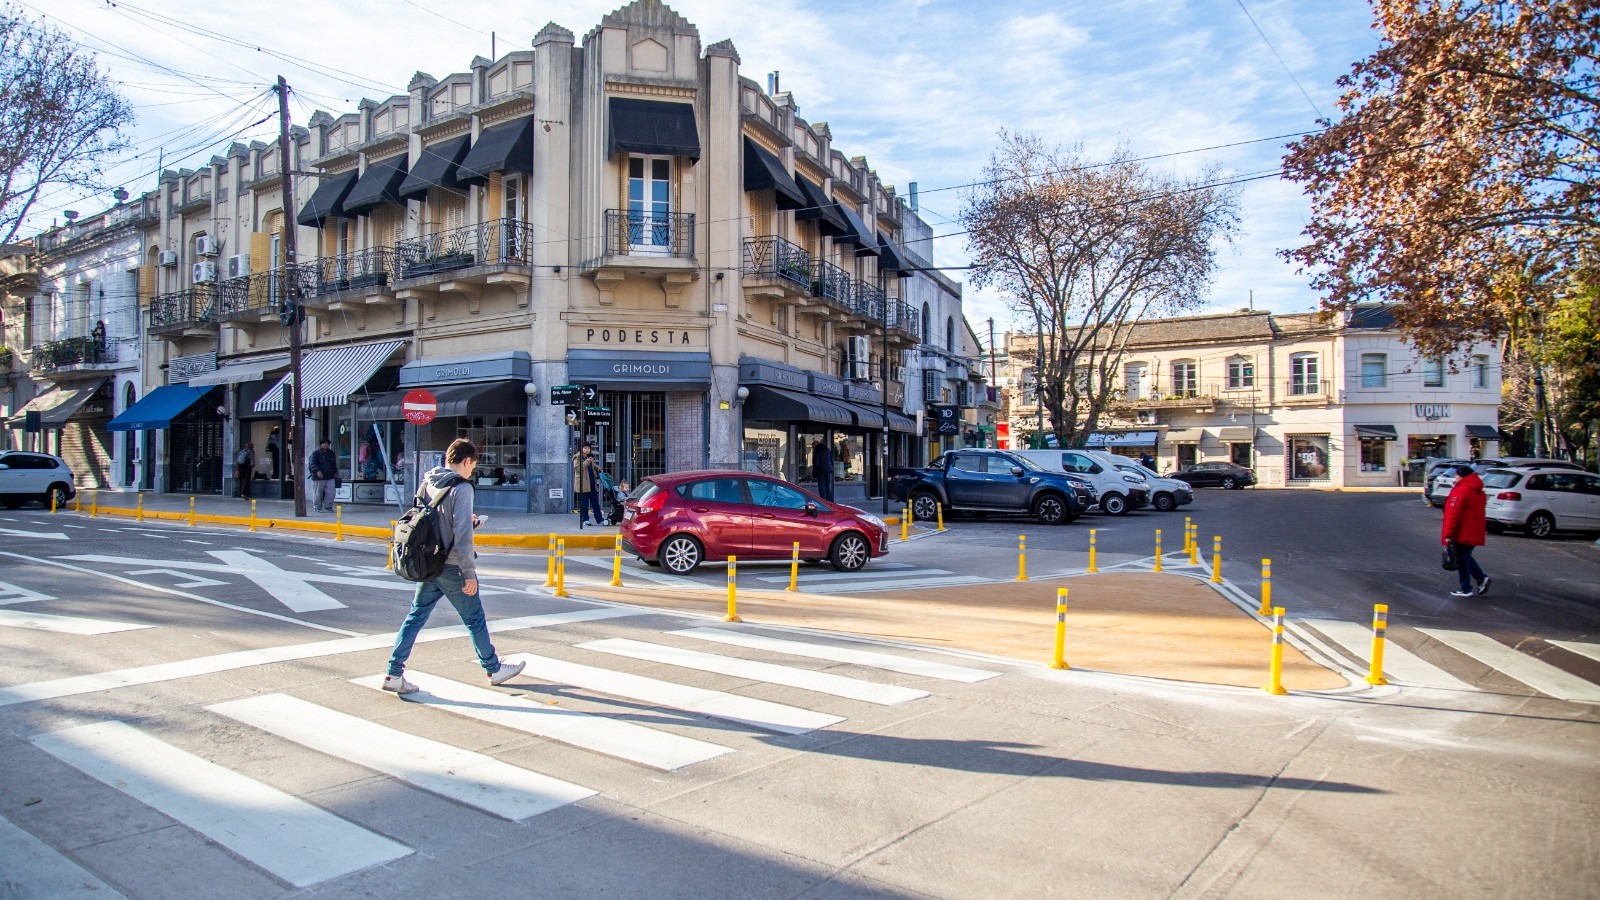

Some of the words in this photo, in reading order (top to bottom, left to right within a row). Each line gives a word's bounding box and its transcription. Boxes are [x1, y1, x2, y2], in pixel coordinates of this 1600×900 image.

[587, 328, 690, 344] PODESTA
[435, 366, 470, 378] GRIMOLDI
[613, 364, 670, 374] GRIMOLDI
[1415, 404, 1452, 418] VONK
